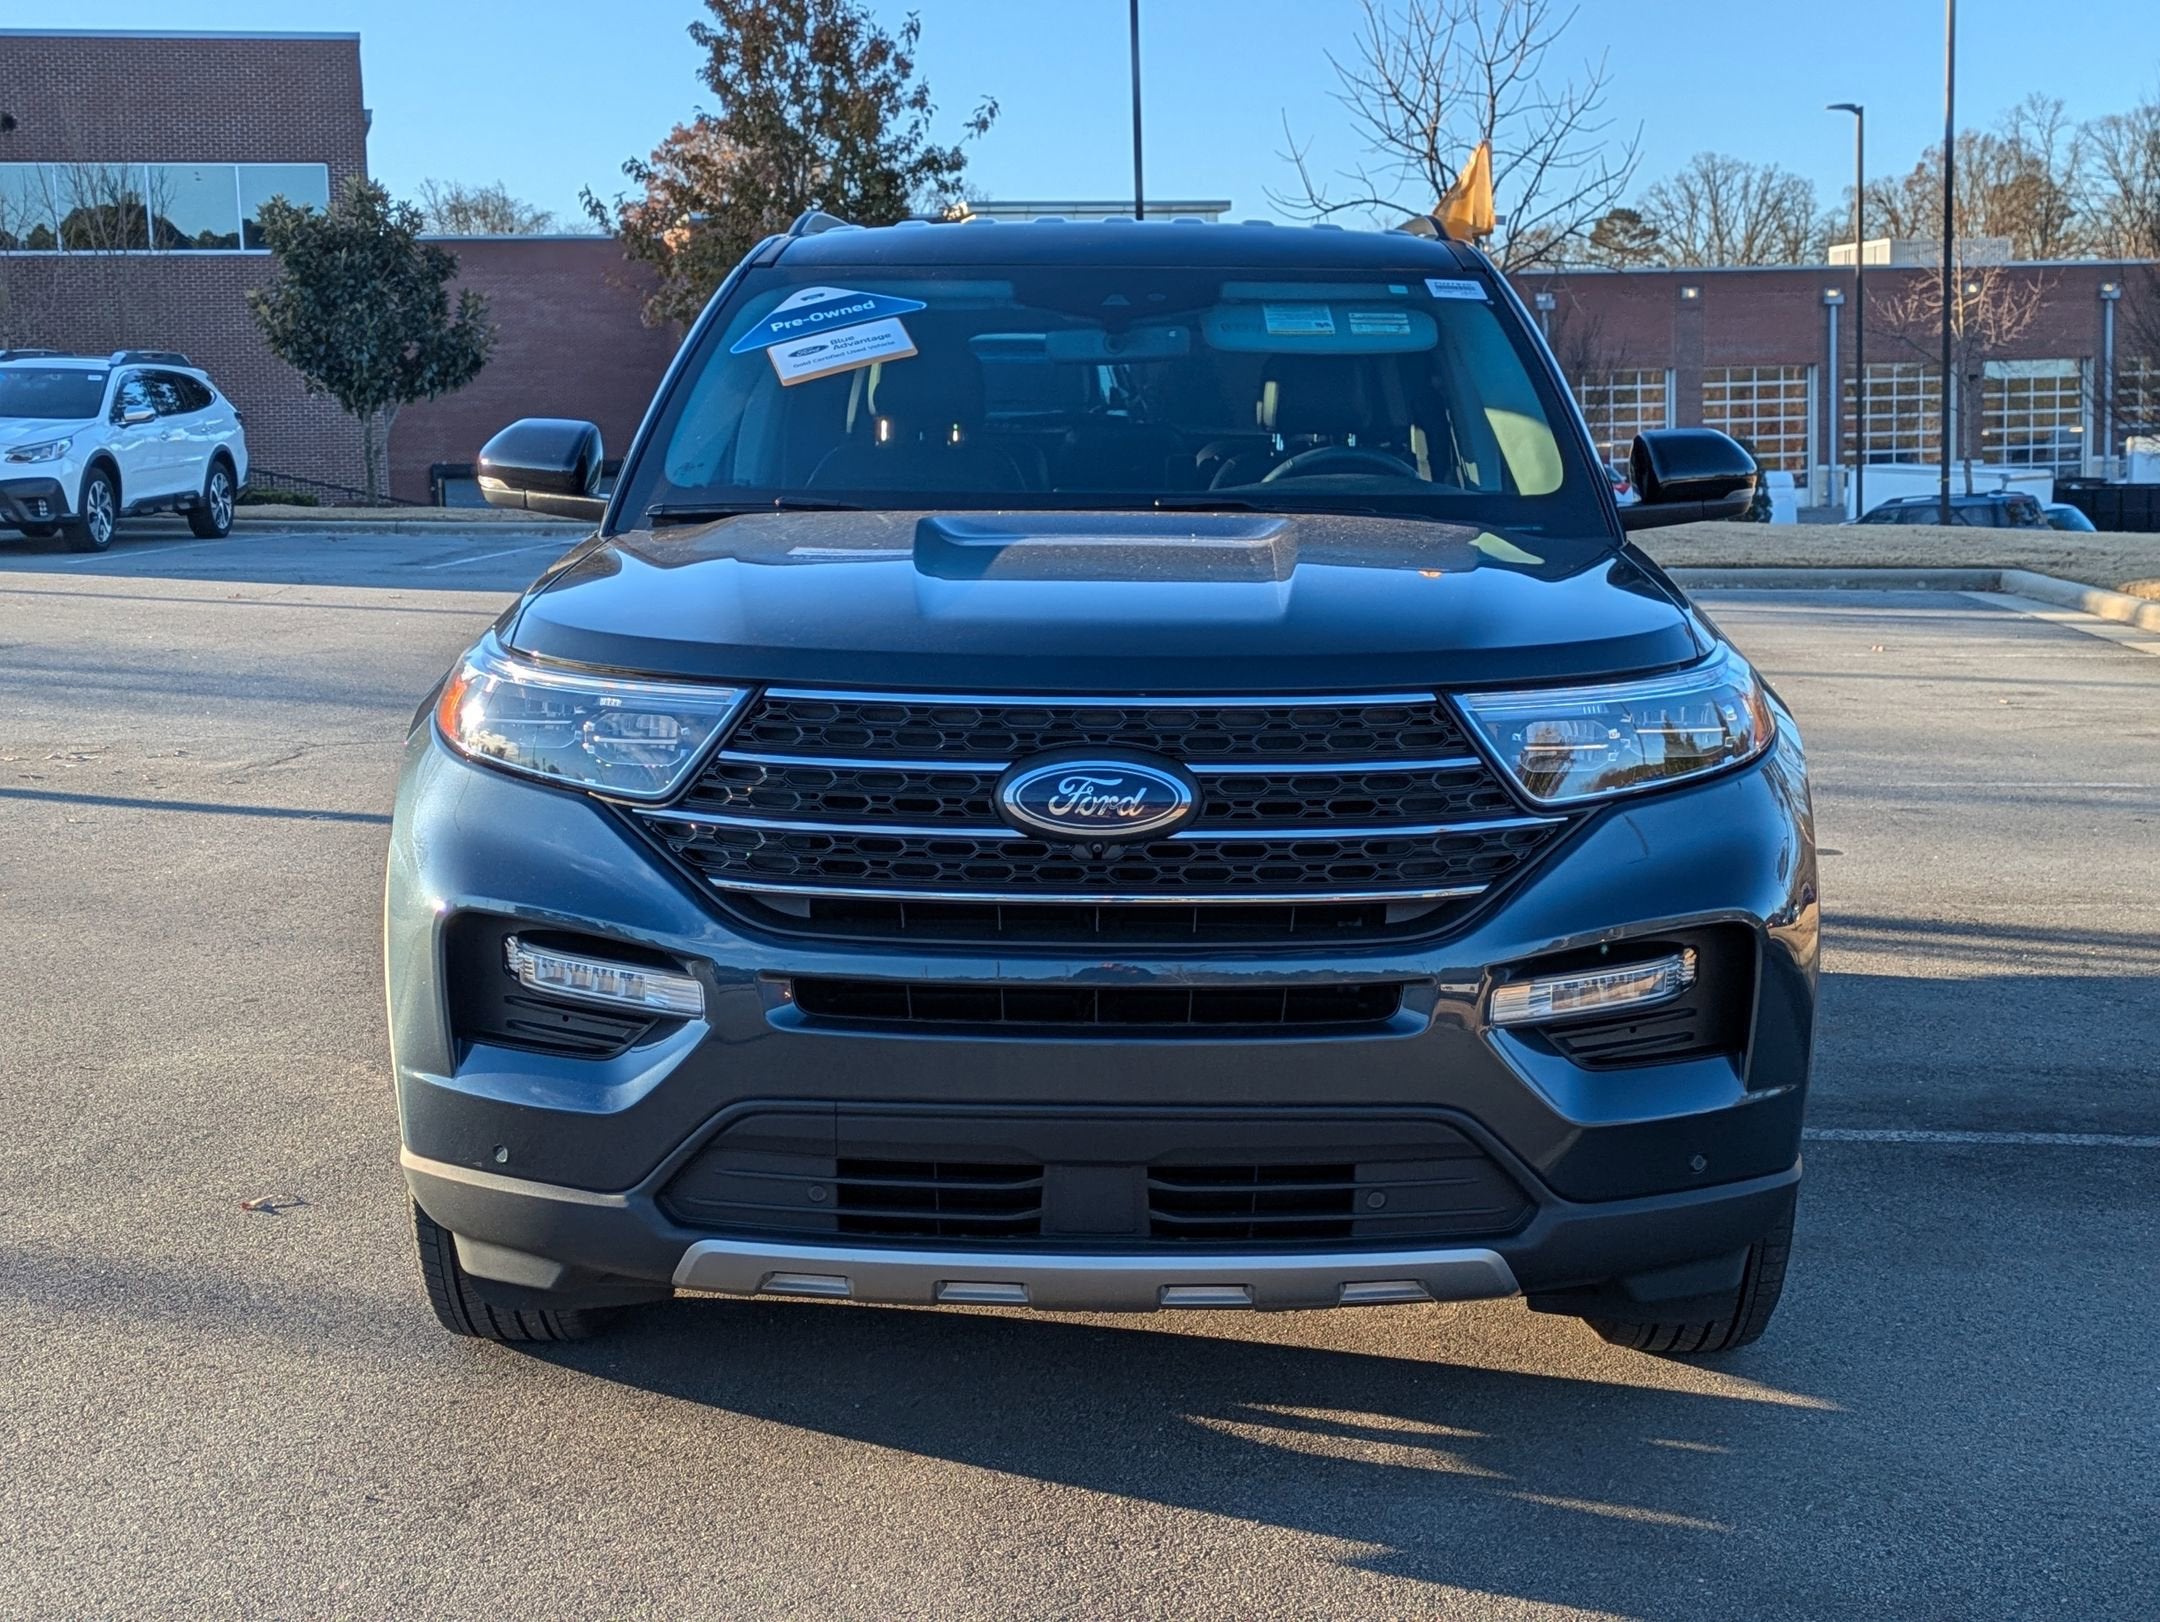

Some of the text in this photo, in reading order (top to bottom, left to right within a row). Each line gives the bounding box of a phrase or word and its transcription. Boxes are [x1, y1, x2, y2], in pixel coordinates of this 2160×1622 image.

[770, 300, 876, 332] Pre-Owned
[830, 335, 855, 346] Blue
[833, 333, 892, 350] Advantage
[813, 352, 845, 363] Certified
[847, 347, 867, 355] Used
[1047, 775, 1147, 817] Ford
